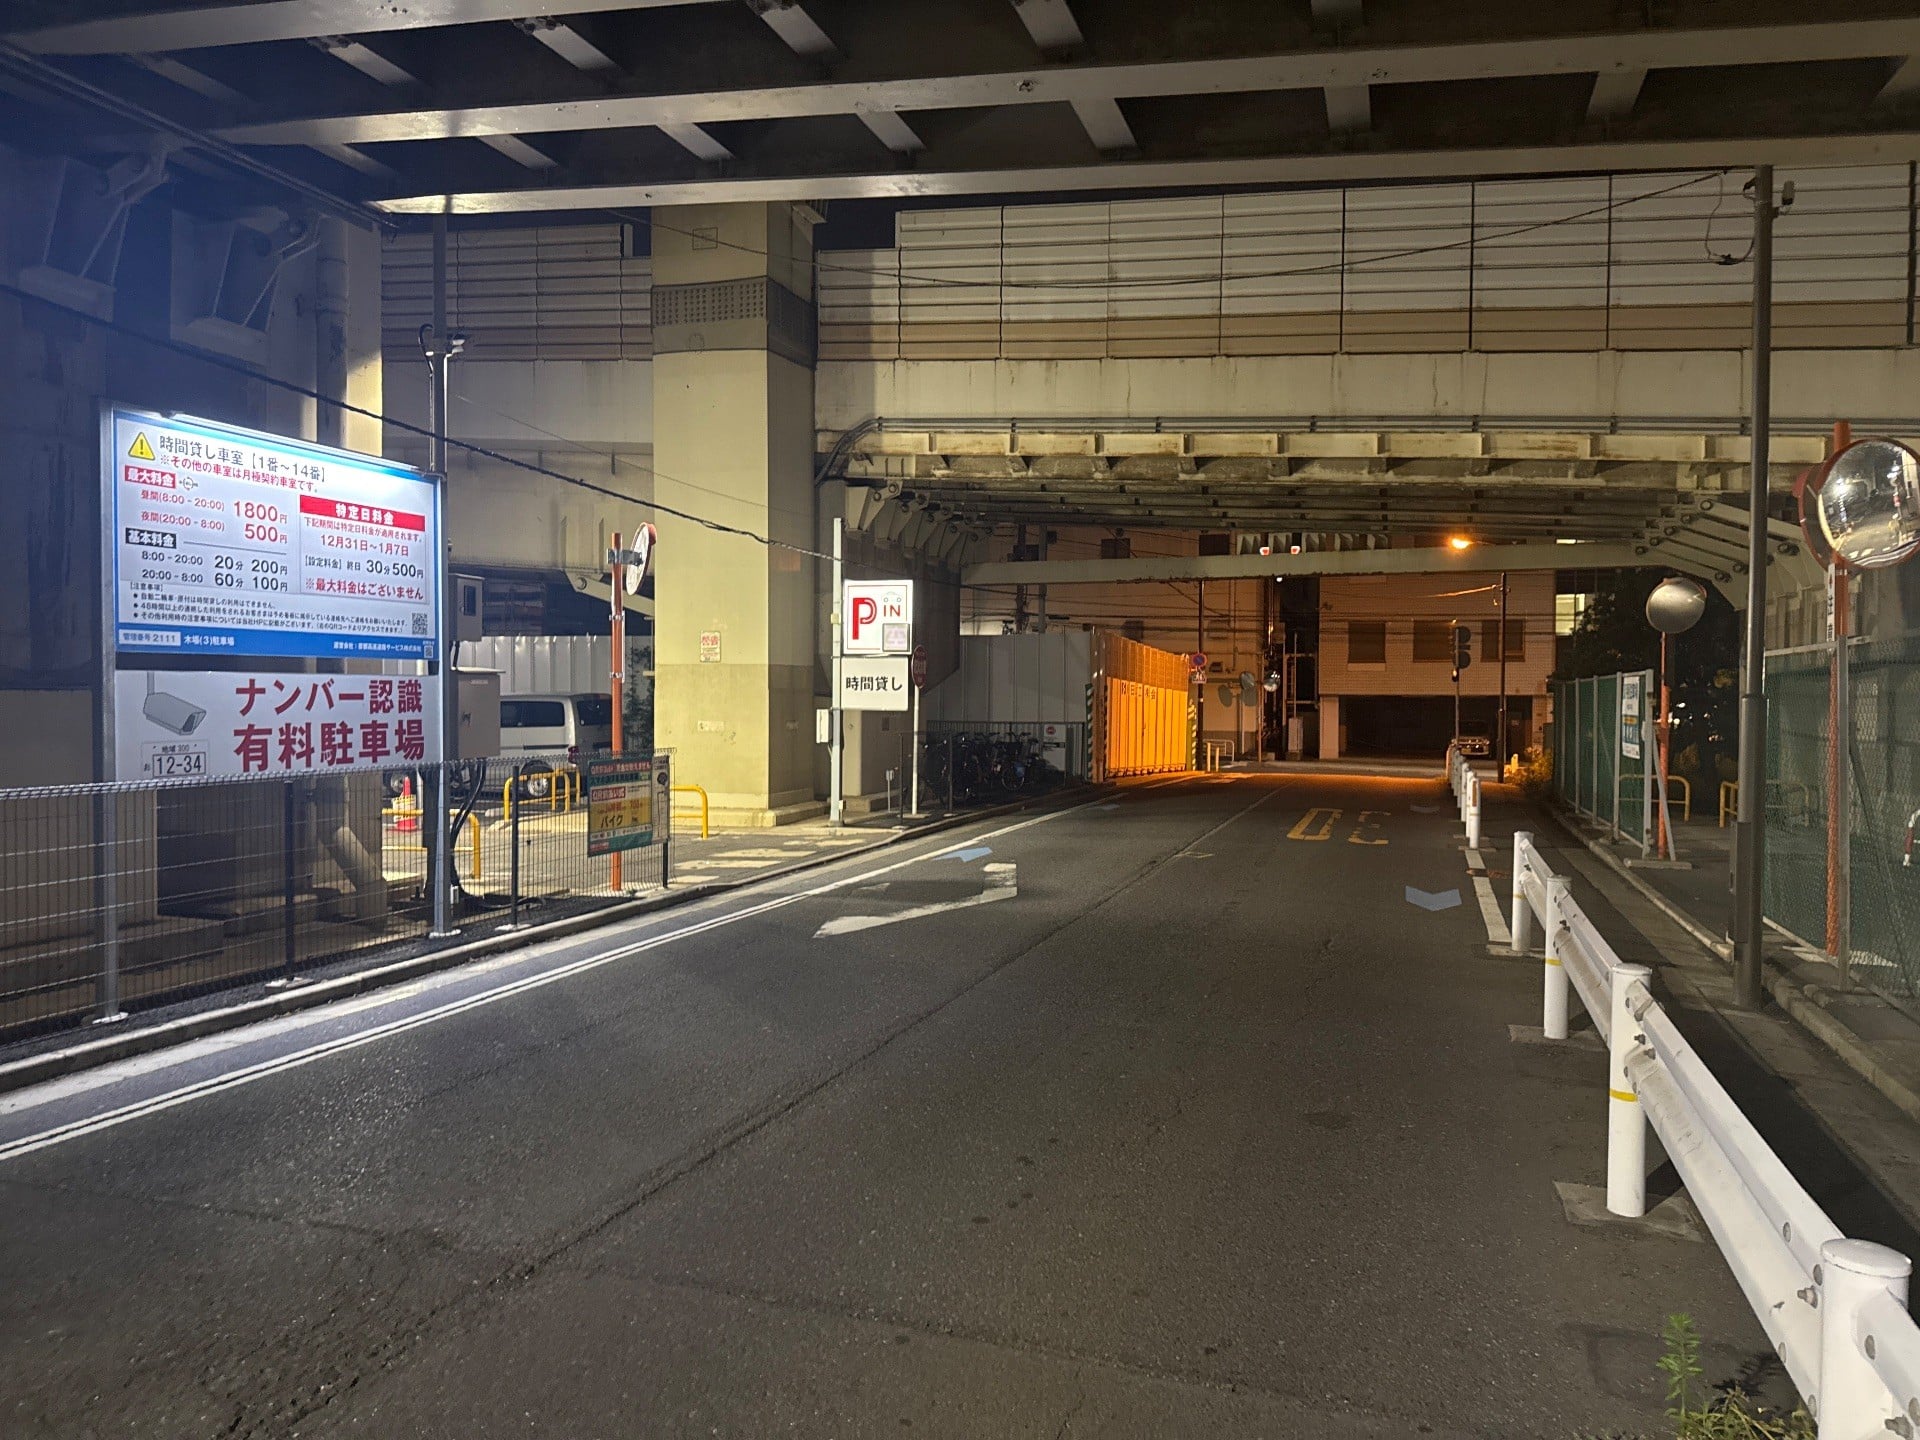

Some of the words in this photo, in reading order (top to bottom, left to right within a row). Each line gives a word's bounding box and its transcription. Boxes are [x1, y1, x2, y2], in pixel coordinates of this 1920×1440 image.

[159, 435, 244, 466] 時間貸し車室
[128, 469, 175, 488] 最大料金
[234, 501, 288, 524] 1800円
[335, 503, 394, 525] 特定日料金
[128, 529, 175, 548] 基本料金
[244, 523, 288, 544] 500円
[305, 577, 424, 600] ※最大料金はございません
[852, 597, 878, 640] P
[883, 604, 901, 617] IN
[845, 676, 903, 692] 時間貸し
[235, 678, 422, 717] ナンバー認識
[233, 719, 425, 773] 有料駐車場
[156, 754, 202, 775] 12-34
